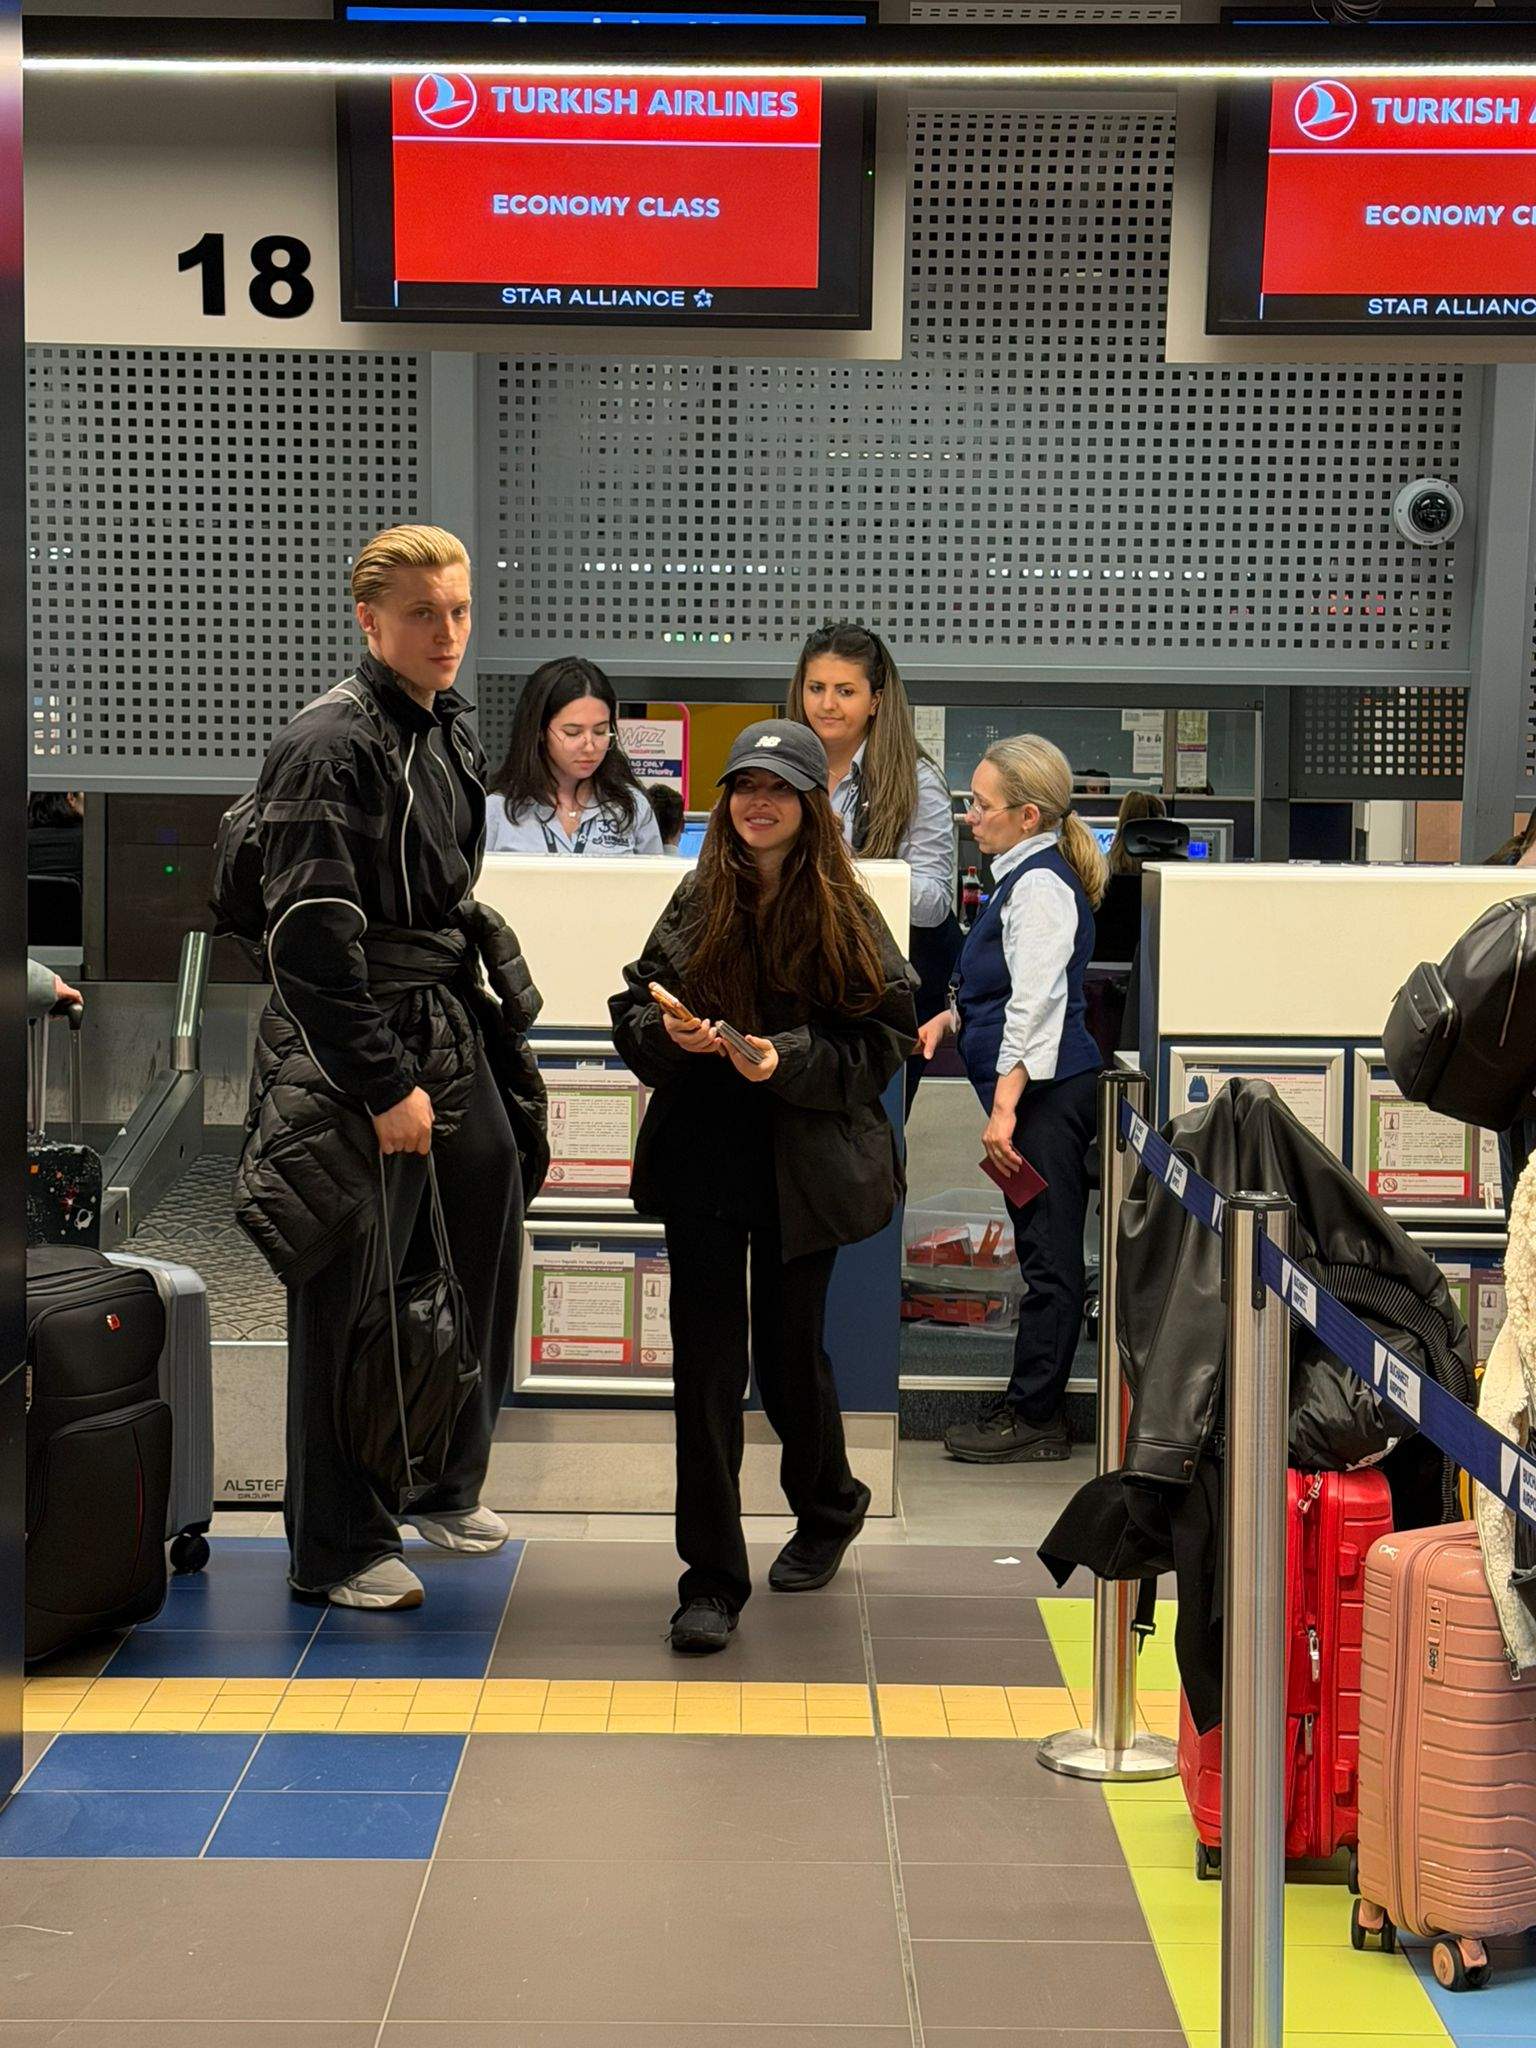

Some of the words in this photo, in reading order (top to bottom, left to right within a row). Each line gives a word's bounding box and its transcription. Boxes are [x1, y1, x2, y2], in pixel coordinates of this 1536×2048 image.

[491, 87, 638, 115] TURKISH
[648, 89, 799, 117] AIRLINES
[1371, 97, 1520, 125] TURKISH
[492, 194, 631, 217] ECONOMY
[637, 197, 721, 218] CLASS
[1365, 205, 1505, 226] ECONOMY
[178, 233, 315, 319] 18
[502, 287, 562, 305] STAR
[568, 289, 685, 307] ALLIANCE
[1367, 298, 1428, 315] STAR
[224, 1479, 285, 1492] ALSTEF
